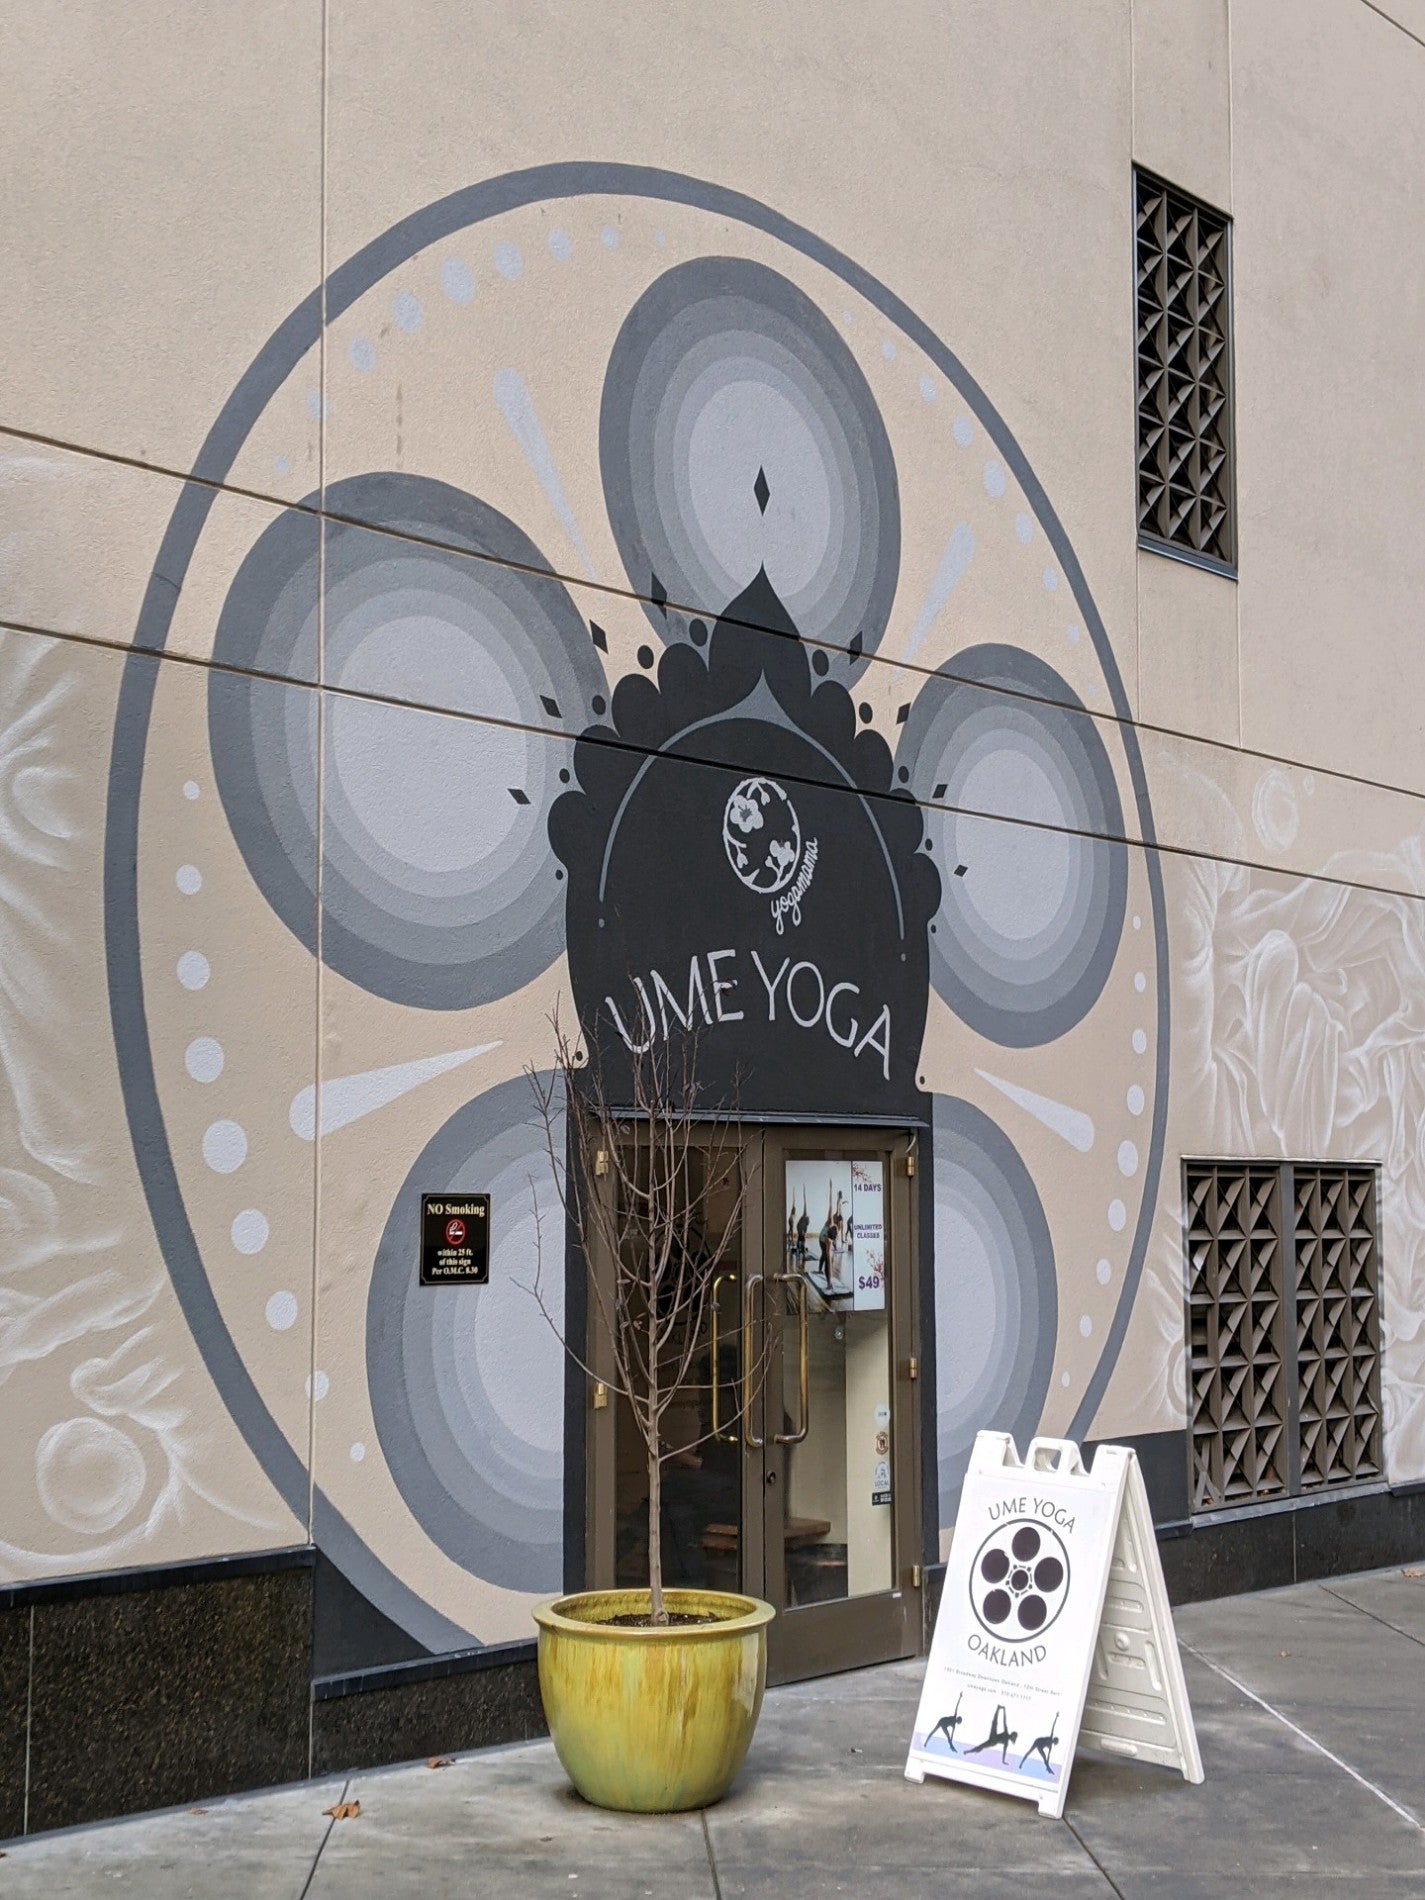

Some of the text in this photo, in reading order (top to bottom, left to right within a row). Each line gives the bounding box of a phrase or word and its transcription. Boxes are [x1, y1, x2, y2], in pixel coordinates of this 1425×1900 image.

[771, 837, 818, 935] yogamama
[605, 949, 890, 1081] UME YOGA
[854, 1183, 882, 1192] 14 DAYS
[427, 1203, 485, 1217] NO Smoking
[853, 1223, 883, 1231] UNLIMITED
[437, 1248, 457, 1256] within
[458, 1248, 465, 1256] 25
[439, 1257, 471, 1267] of this sign
[432, 1267, 442, 1275] Per
[858, 1275, 880, 1290] $49
[988, 1497, 1076, 1534] UME YOGA
[967, 1634, 1047, 1668] OAKLAND
